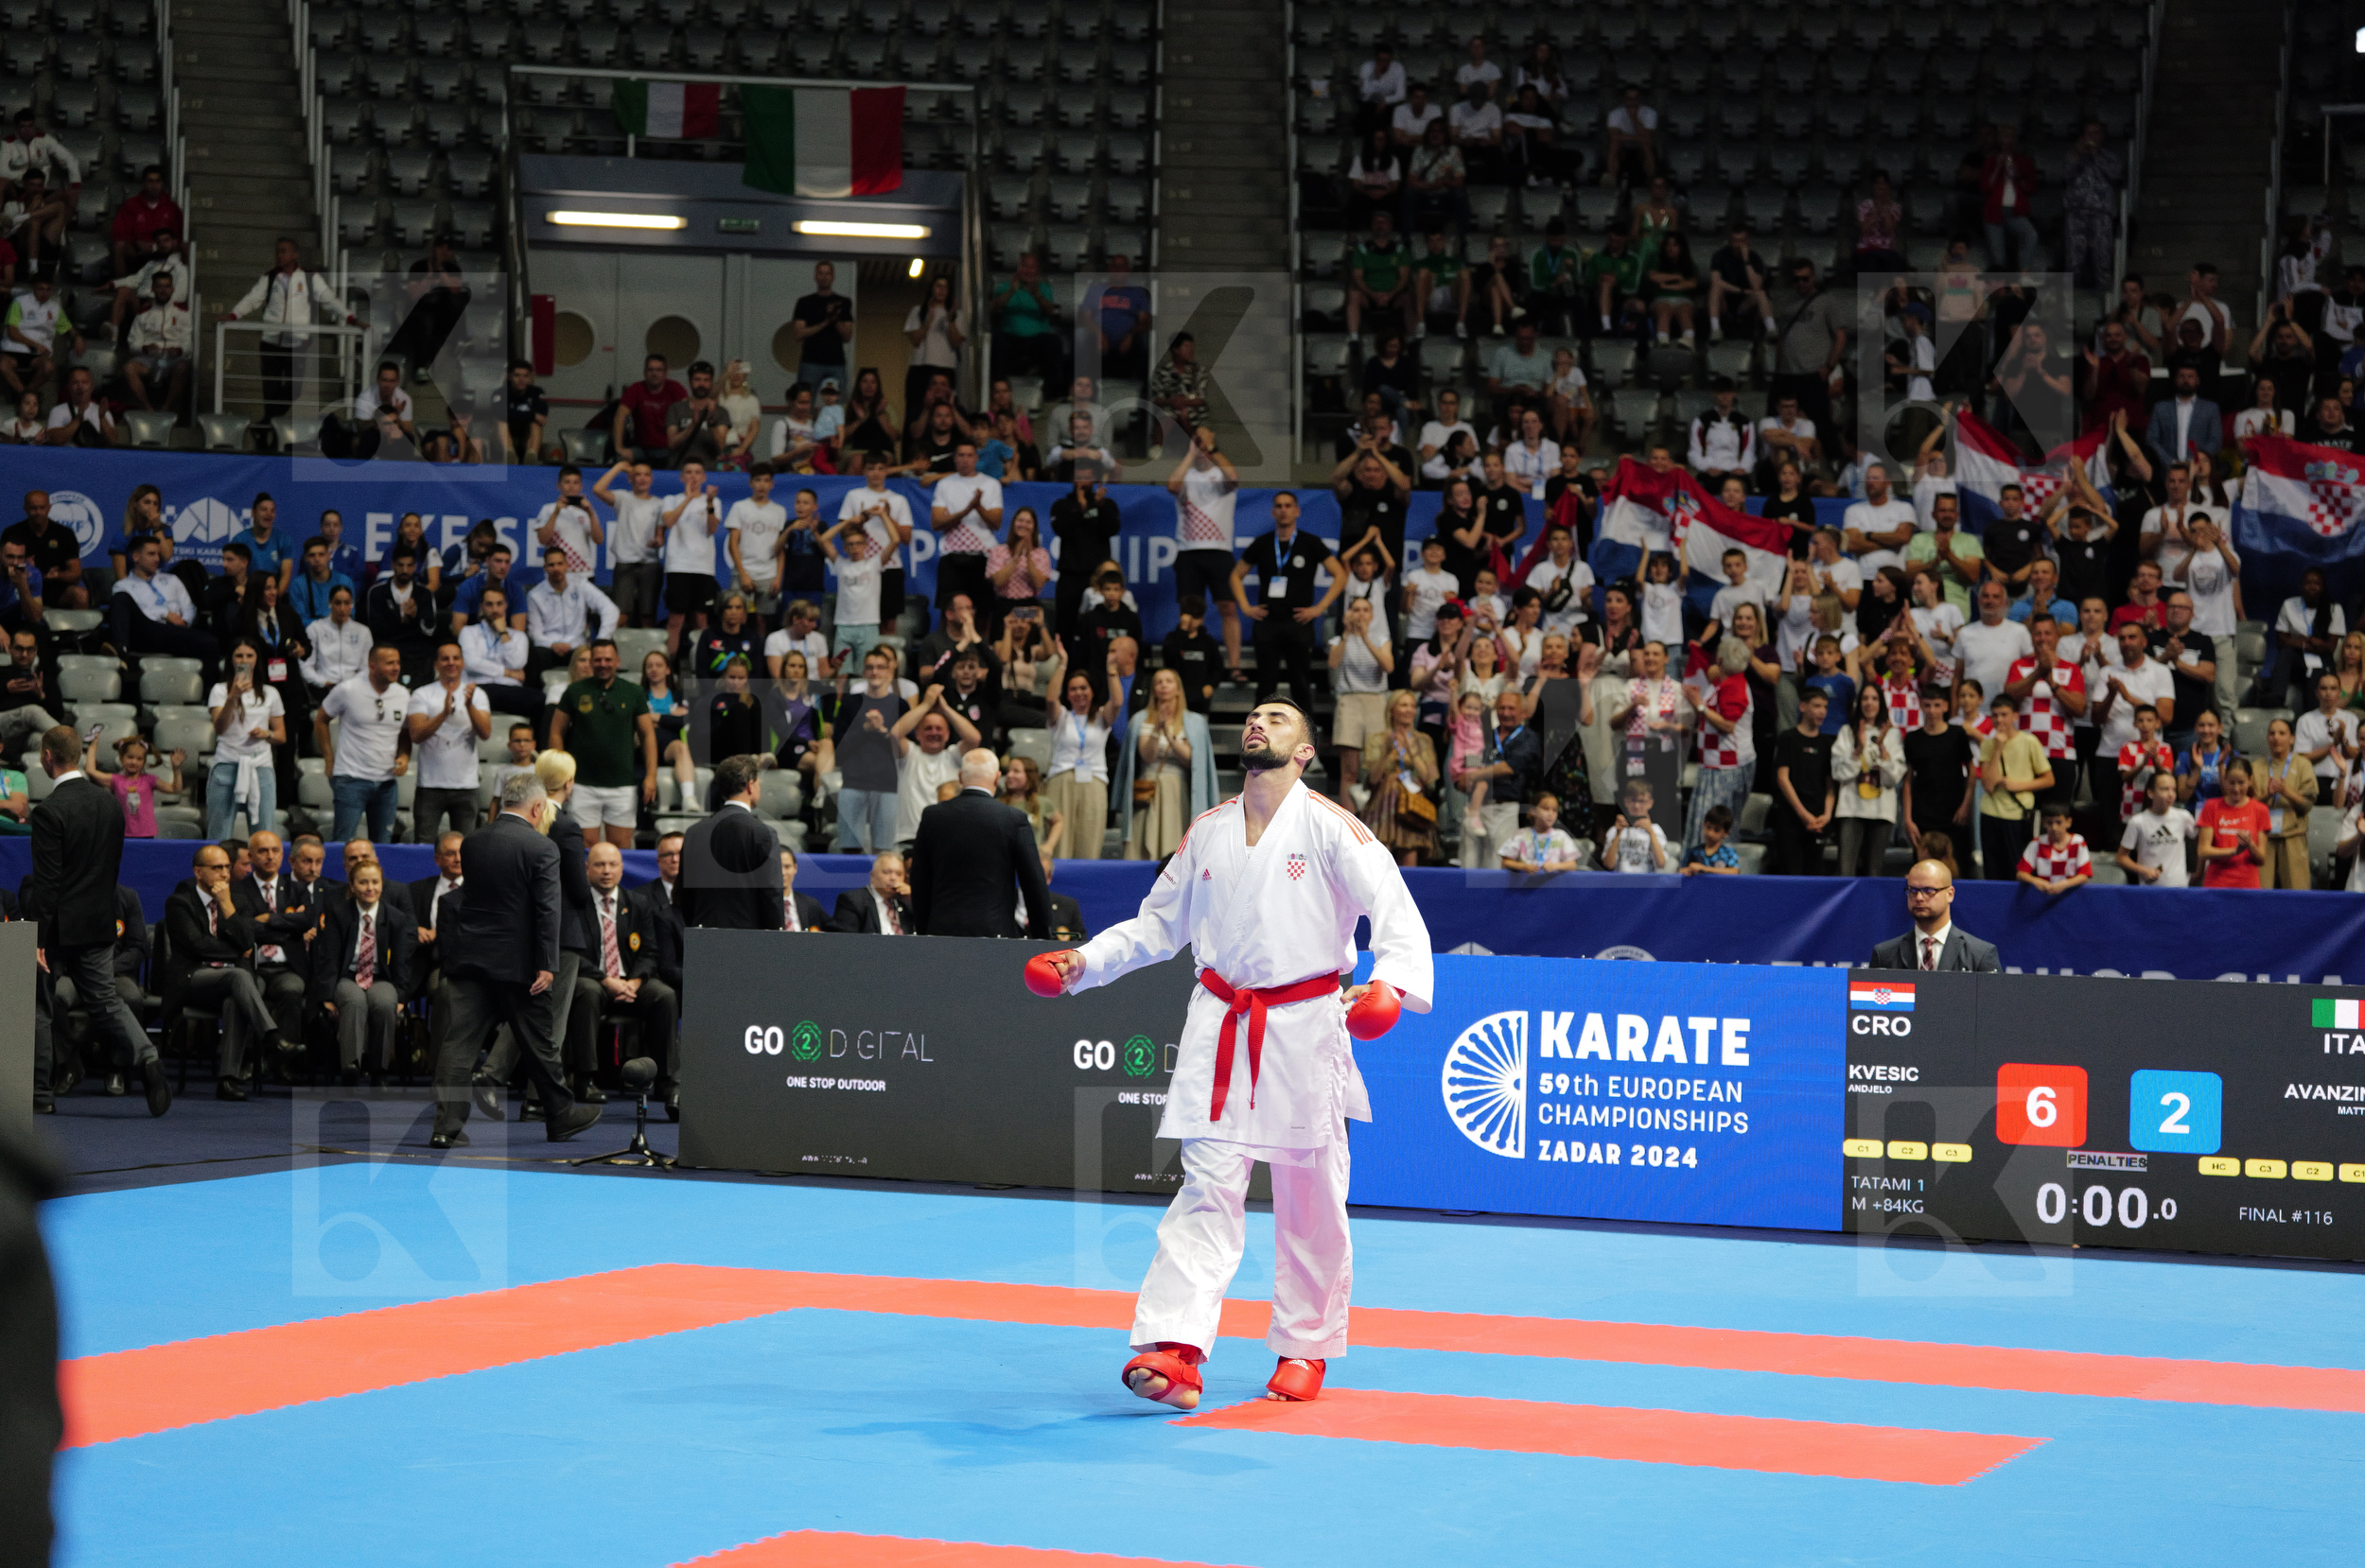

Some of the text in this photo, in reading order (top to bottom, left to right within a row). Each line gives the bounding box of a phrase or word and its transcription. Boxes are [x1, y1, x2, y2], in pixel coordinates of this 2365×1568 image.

[1852, 1016, 1912, 1037] CRO
[745, 1025, 784, 1055] GO
[1539, 1011, 1750, 1066] KARATE
[2323, 1033, 2365, 1054] ITA
[1074, 1039, 1115, 1071] GO
[1848, 1064, 1919, 1082] KVESIC
[786, 1076, 886, 1091] ONE STOP OUTDOOR
[1538, 1072, 1743, 1103] 59th EUROPEAN
[1848, 1084, 1893, 1094] ANDJELO
[1118, 1091, 1140, 1105] ONE
[2025, 1086, 2058, 1127] 6
[1538, 1103, 1749, 1134] CHAMPIONSHIPS
[2158, 1091, 2191, 1134] 2
[1538, 1140, 1698, 1169] ZADAR 2024
[2068, 1154, 2147, 1169] PENALTIES
[2212, 1162, 2227, 1171] HC
[2306, 1167, 2320, 1176] C2
[1851, 1176, 1924, 1192] TATAMI 1
[1852, 1197, 1924, 1213] M +84KG
[2239, 1207, 2333, 1226] FINAL #116
